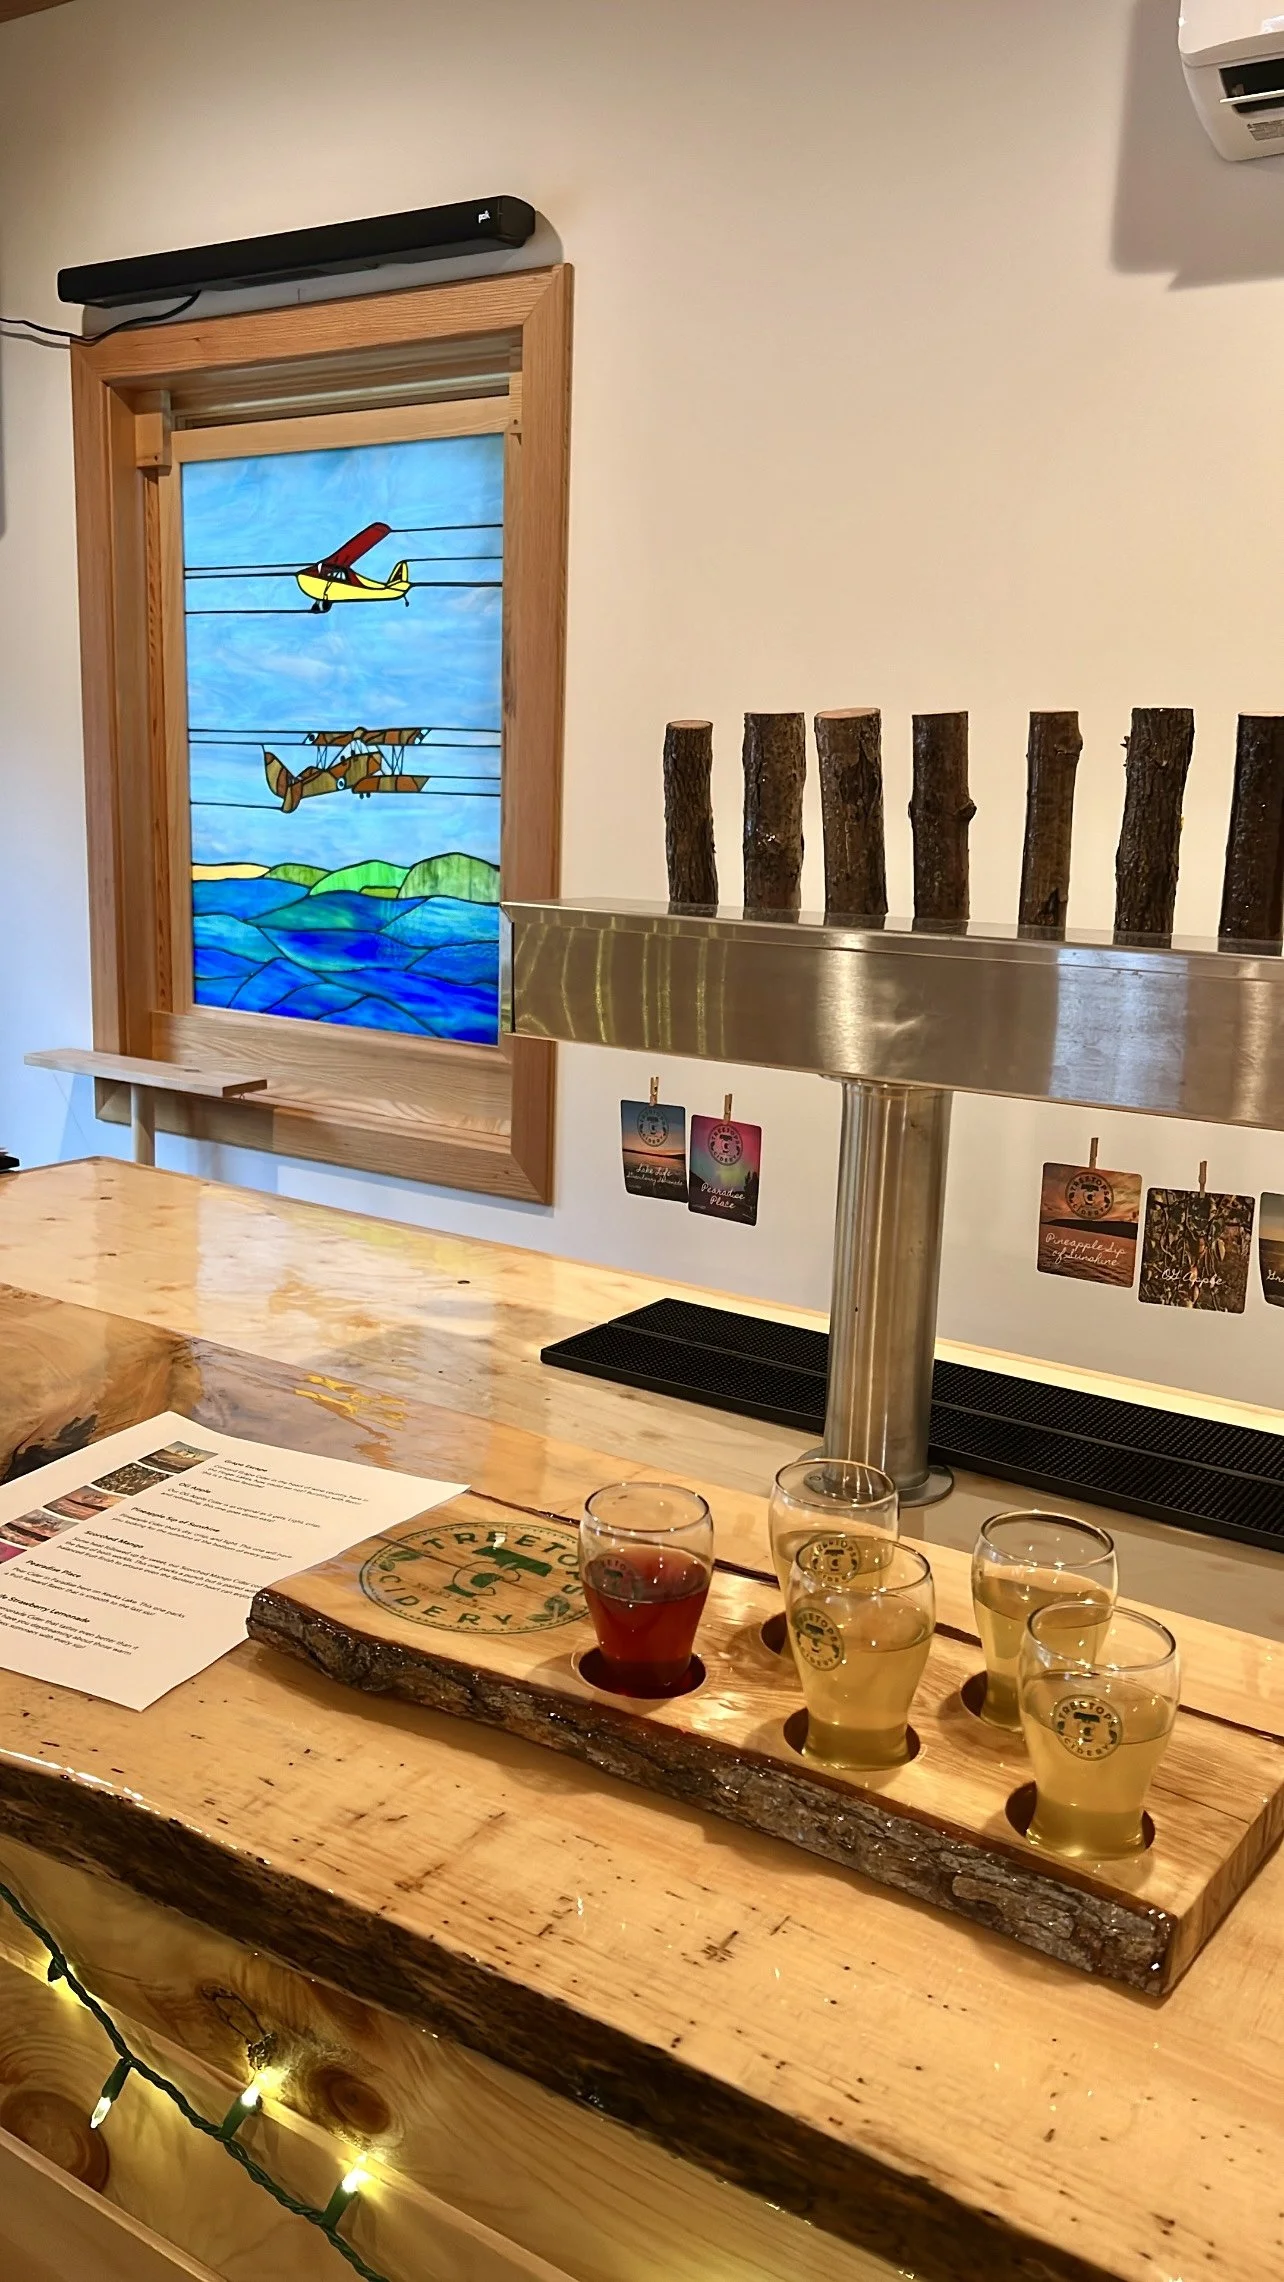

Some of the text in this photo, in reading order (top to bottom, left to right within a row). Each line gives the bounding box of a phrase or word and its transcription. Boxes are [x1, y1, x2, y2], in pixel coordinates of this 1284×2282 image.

[701, 1182, 746, 1200] Pearadise
[710, 1195, 736, 1209] Place
[1045, 1232, 1104, 1253] Pineapple
[380, 1575, 512, 1625] CIDERY
